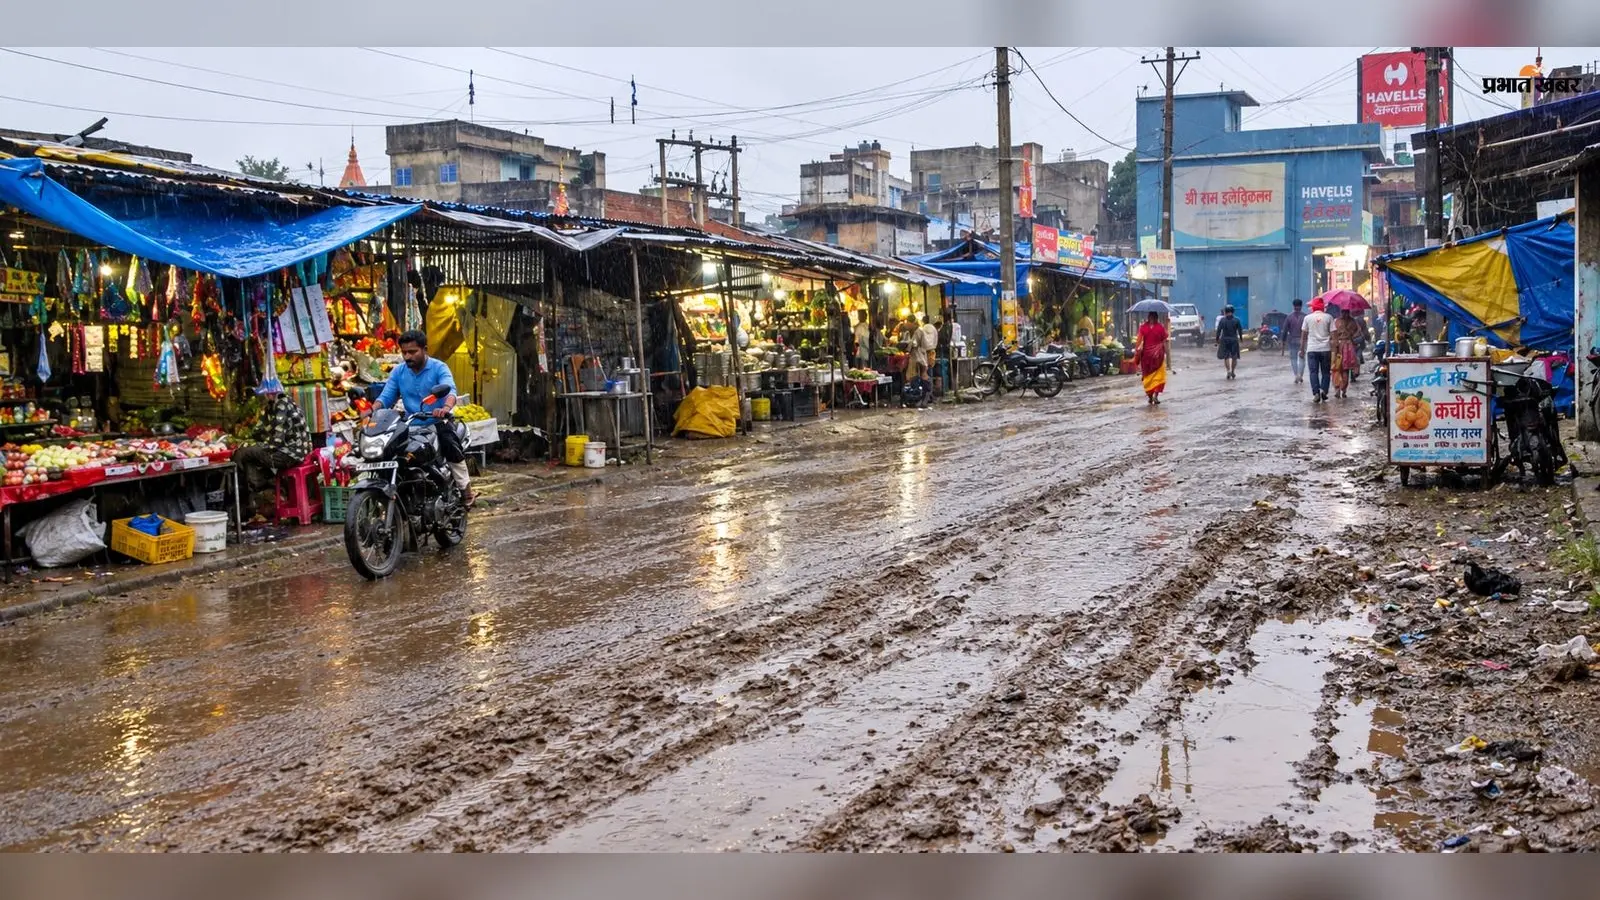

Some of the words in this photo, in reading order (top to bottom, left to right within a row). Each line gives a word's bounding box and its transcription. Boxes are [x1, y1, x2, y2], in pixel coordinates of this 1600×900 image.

[1366, 88, 1427, 104] HAVELLS
[1185, 188, 1198, 206] श्री
[1201, 191, 1218, 206] राम
[1301, 185, 1353, 199] HAVELLS
